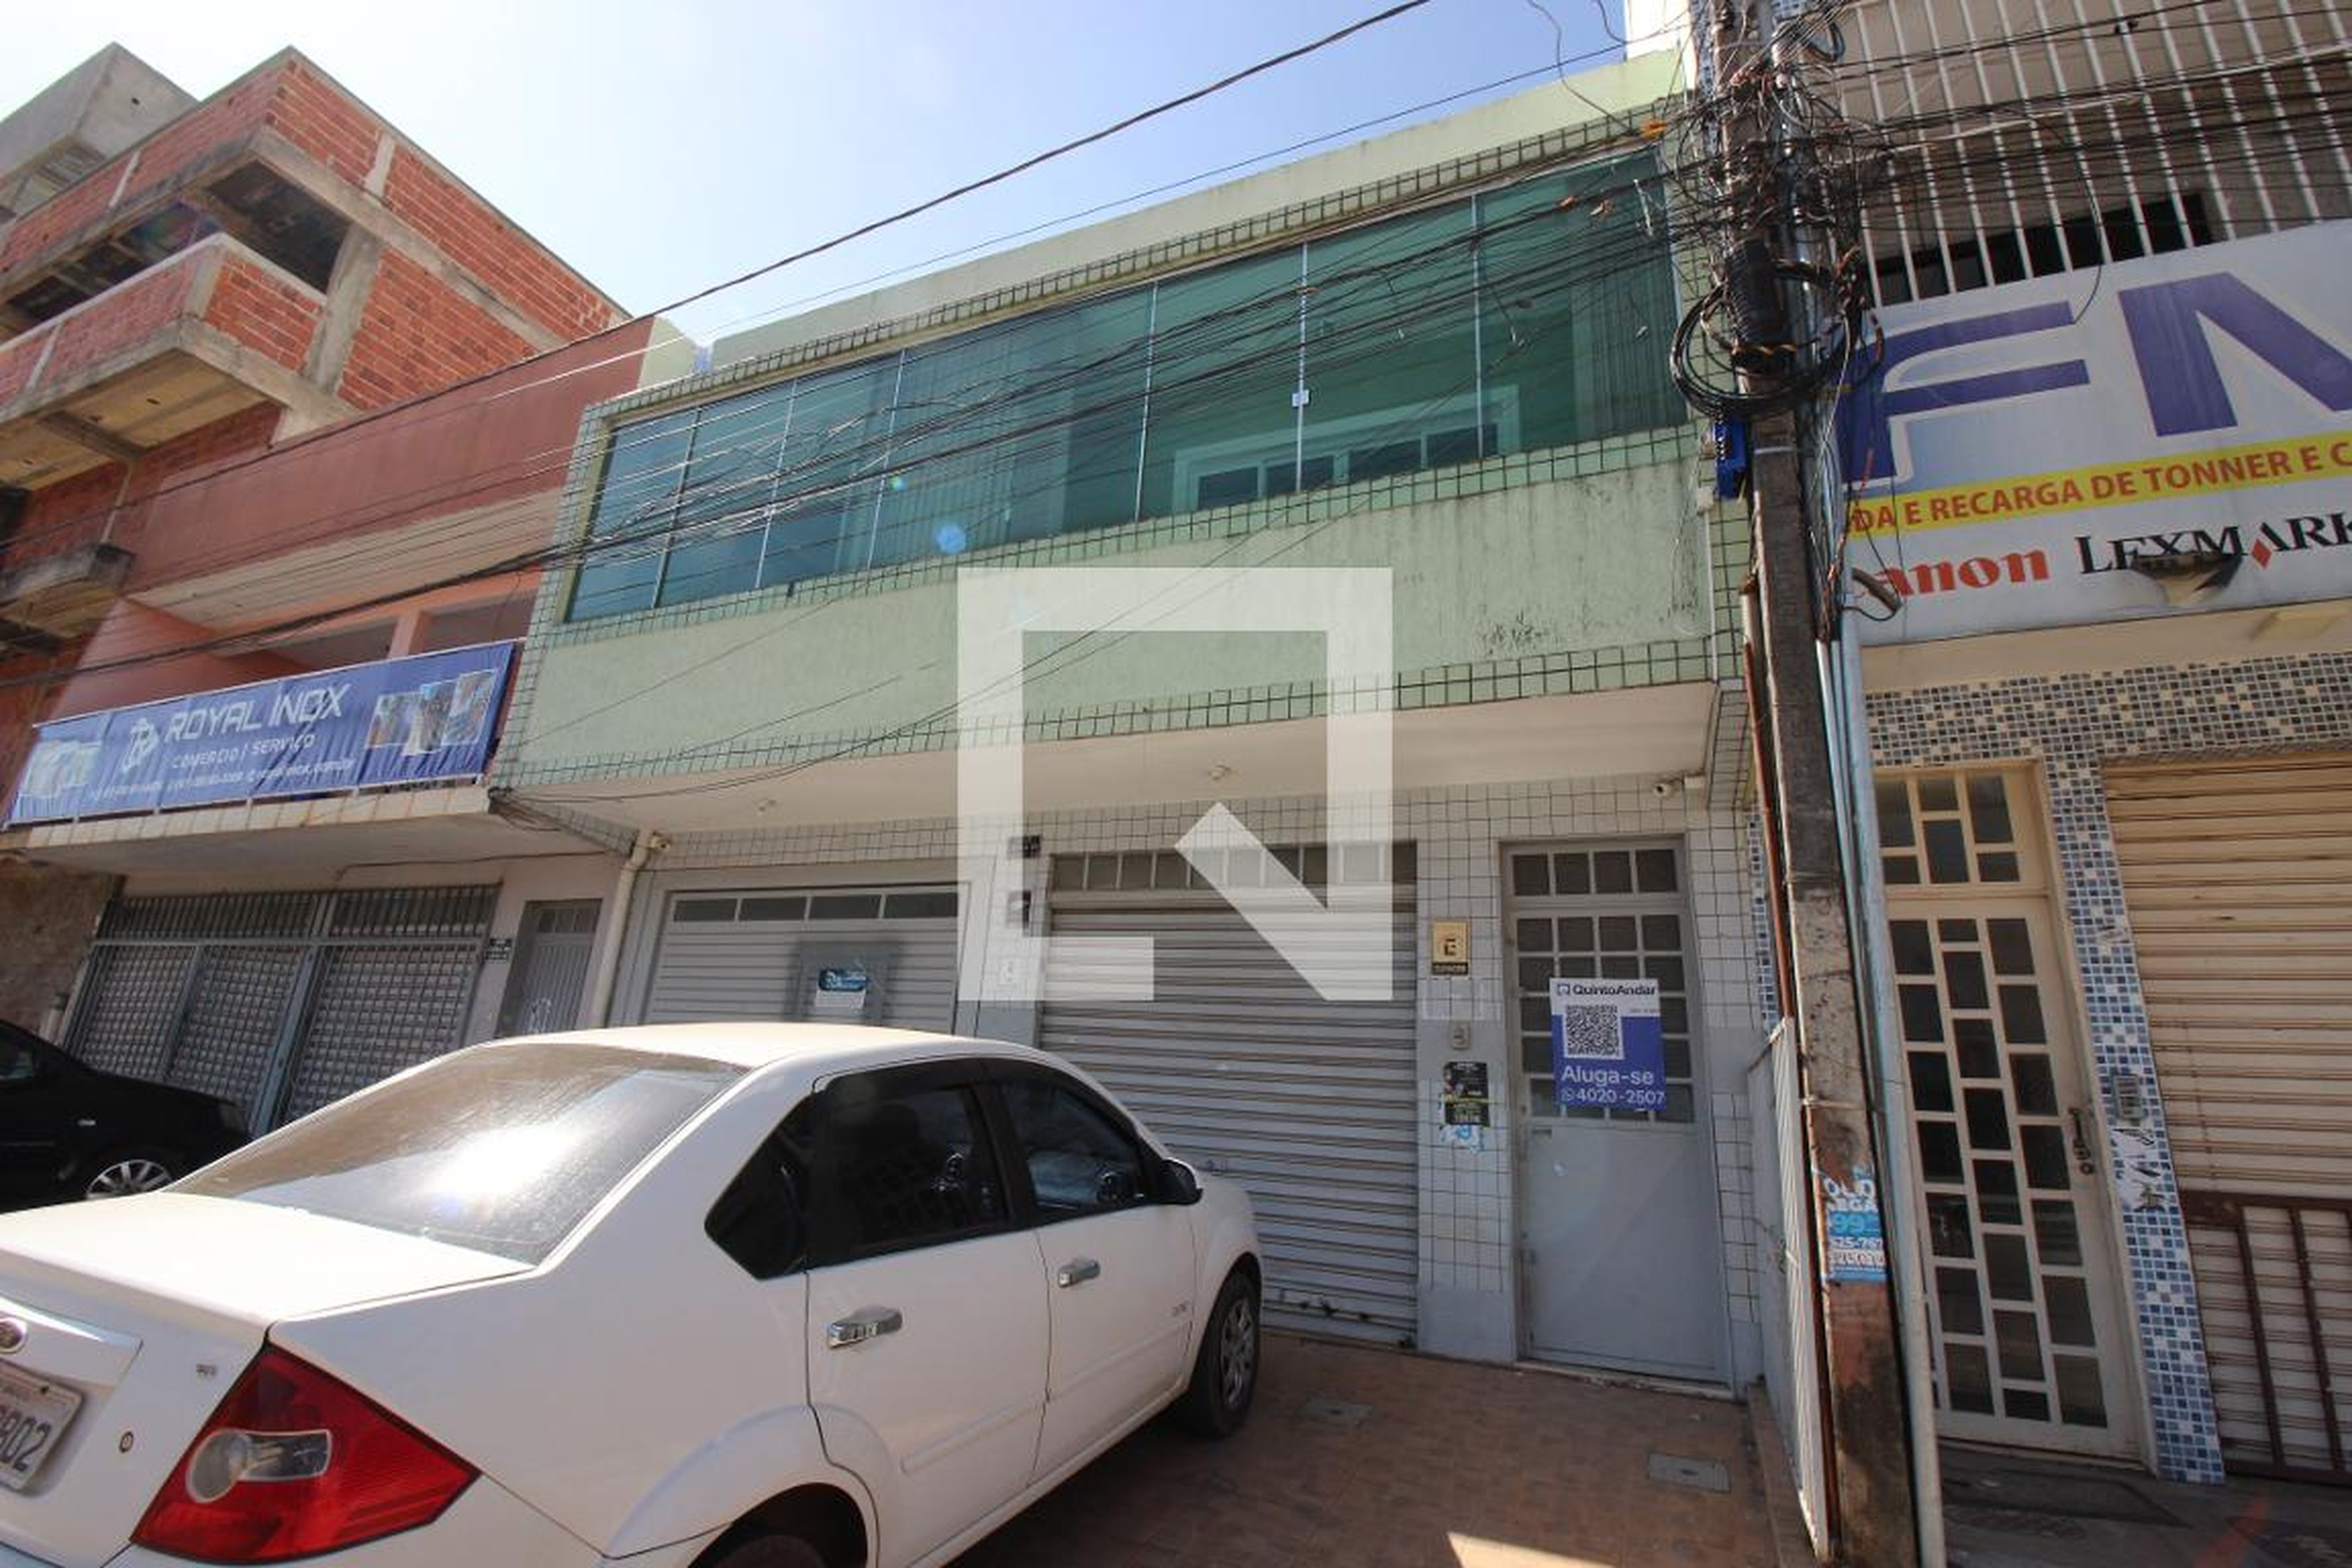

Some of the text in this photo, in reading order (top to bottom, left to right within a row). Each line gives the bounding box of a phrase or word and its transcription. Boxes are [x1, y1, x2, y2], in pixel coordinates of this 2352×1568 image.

[1905, 499, 1923, 525] E
[1929, 478, 2084, 522] RECARGA
[2090, 471, 2138, 500] DE
[2143, 450, 2294, 492] TONNER
[2299, 446, 2324, 472] E
[164, 683, 351, 743] ROYAL INOX
[1572, 984, 1655, 996] QuintoAndar
[1561, 1065, 1654, 1087] Aluga-se
[1576, 1088, 1665, 1105] 4020-2507
